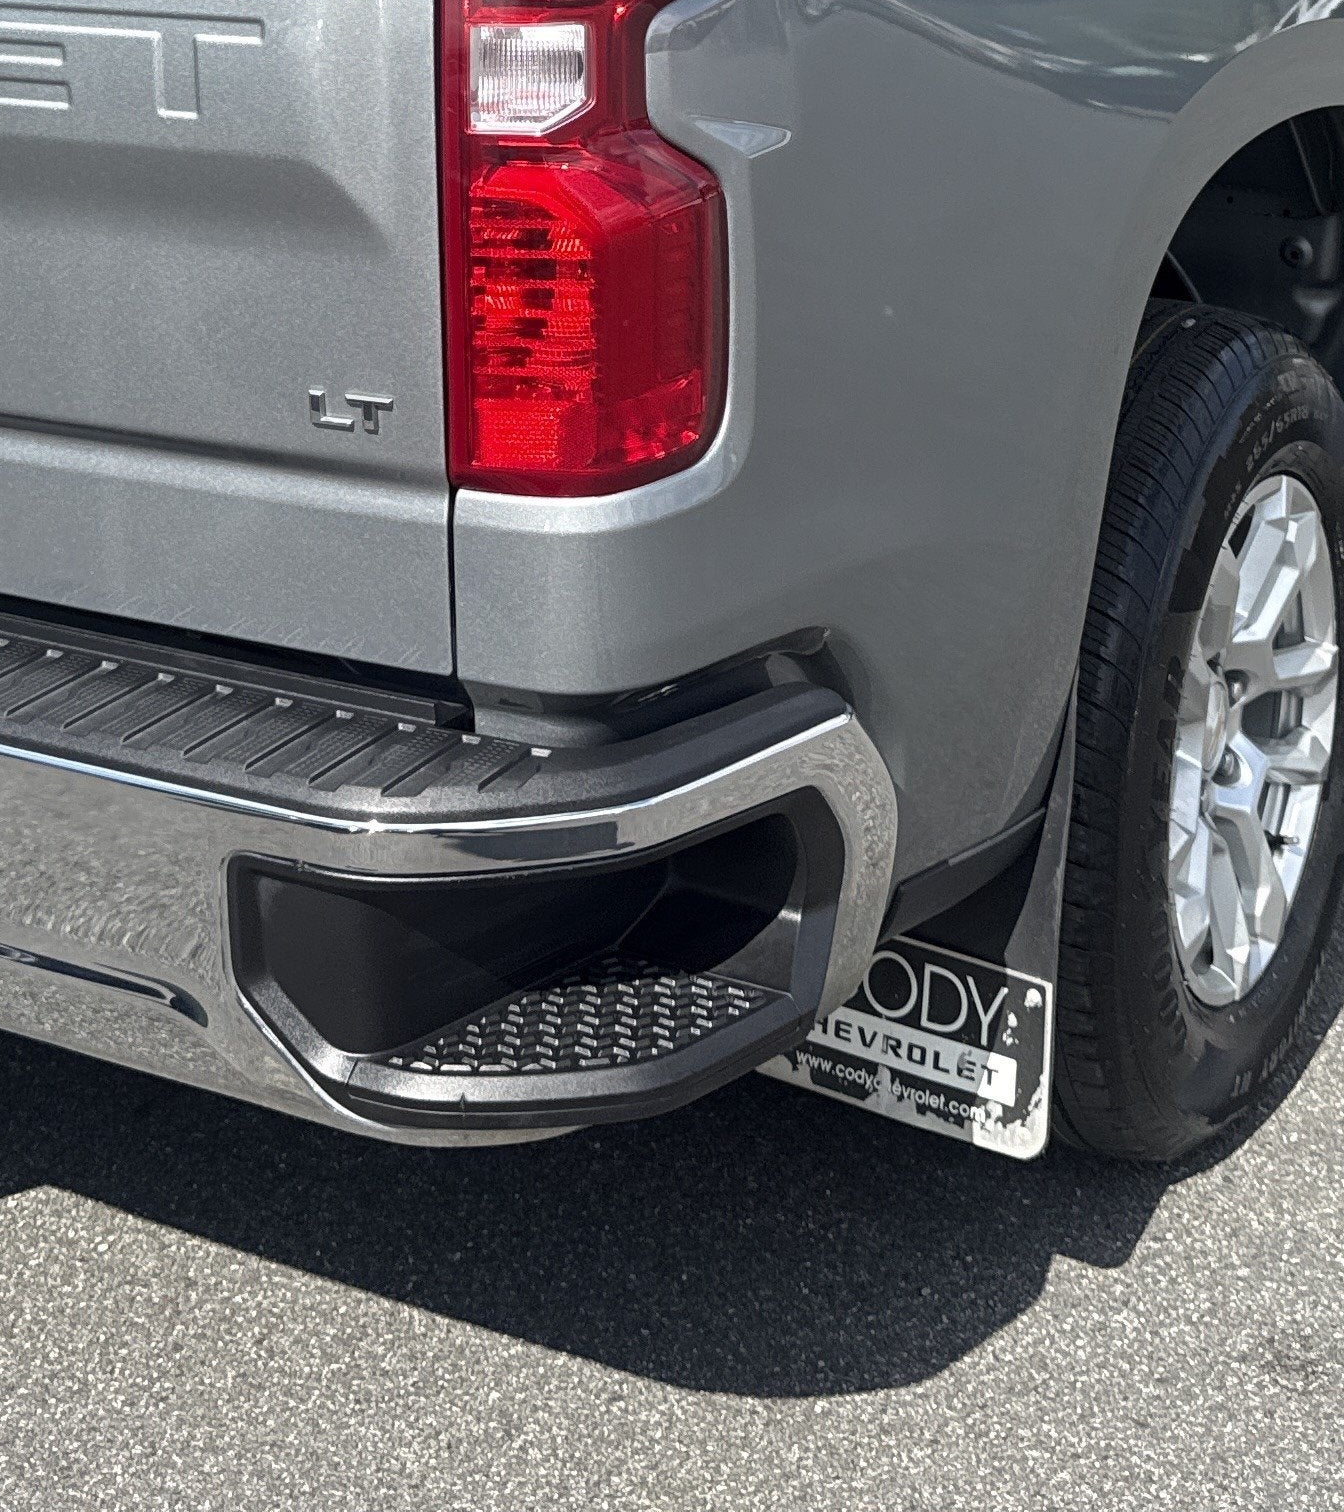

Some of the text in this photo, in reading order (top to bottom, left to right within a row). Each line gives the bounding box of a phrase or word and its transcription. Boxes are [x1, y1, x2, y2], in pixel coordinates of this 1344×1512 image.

[308, 385, 394, 434] LT
[863, 950, 1008, 1046] ODY
[816, 1016, 999, 1086] HEVROLET
